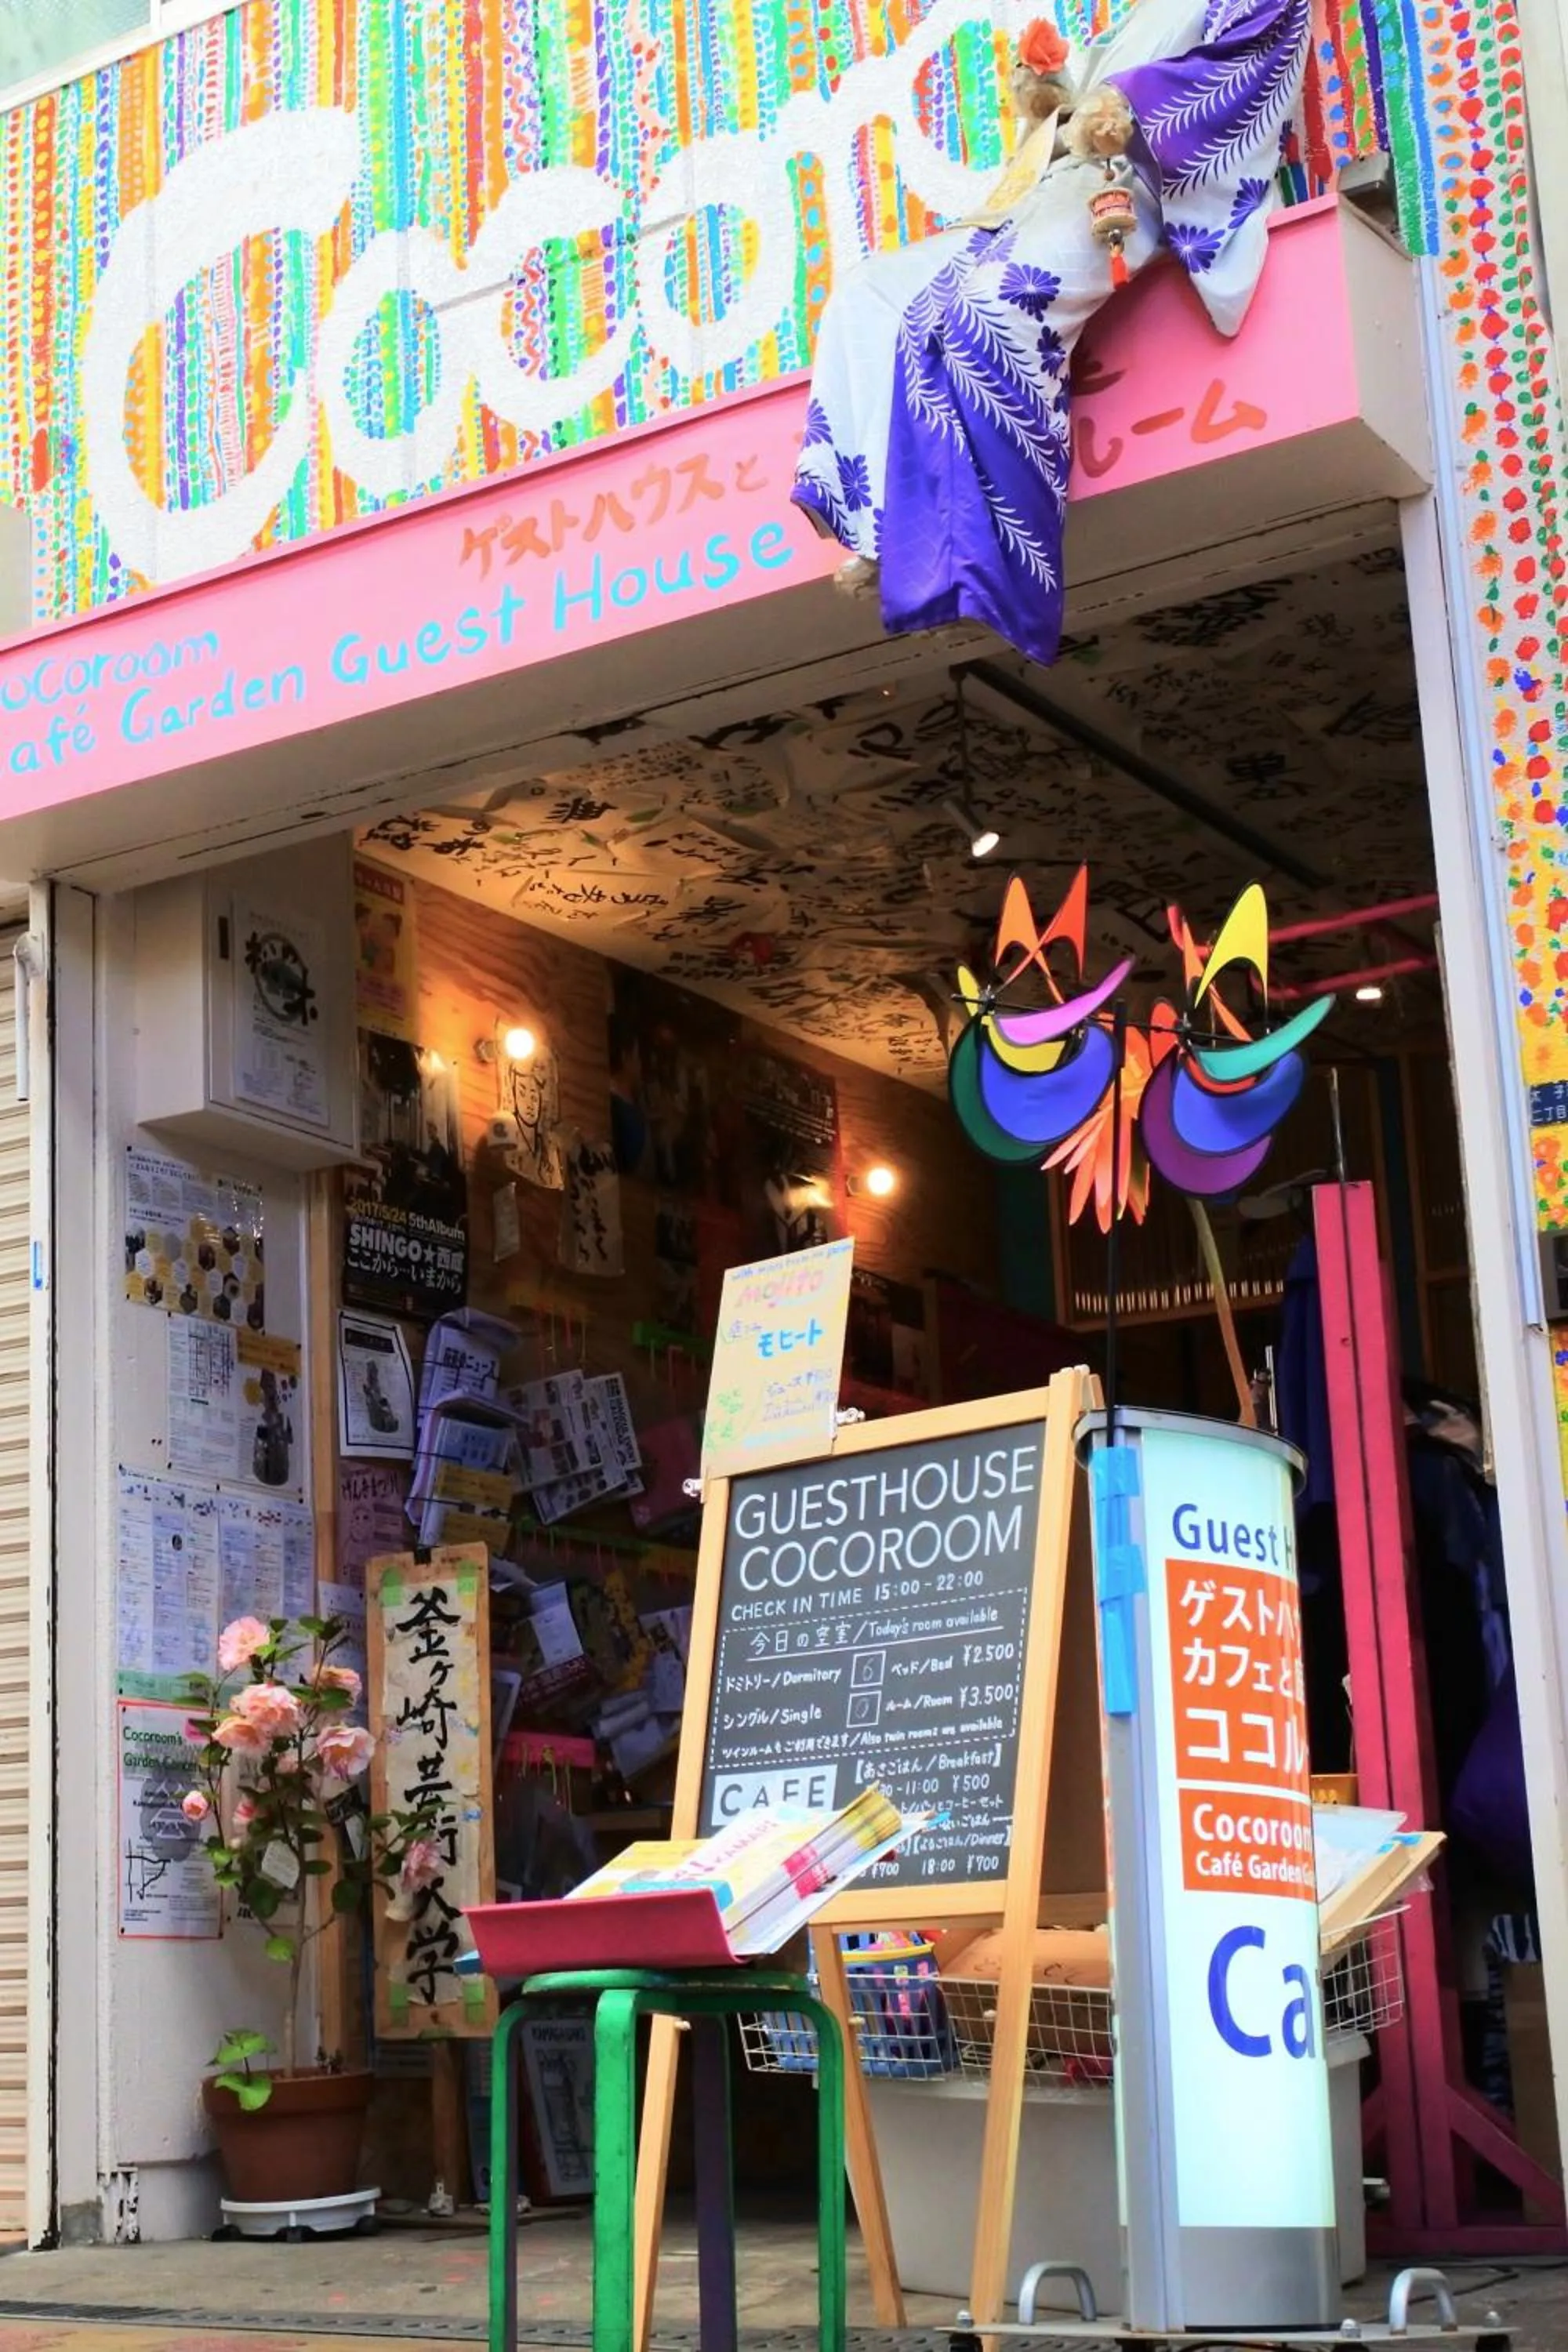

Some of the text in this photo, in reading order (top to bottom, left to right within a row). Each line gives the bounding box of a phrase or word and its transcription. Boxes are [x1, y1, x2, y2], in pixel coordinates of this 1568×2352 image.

[82, 0, 1058, 584] Cocoro
[0, 521, 794, 775] afé Garden Guest House
[756, 1317, 824, 1358] モヒート
[735, 1444, 1038, 1540] GUESTHOUSE
[739, 1504, 1023, 1592] COCOROOM
[1171, 1503, 1279, 1566] Guest
[731, 1599, 787, 1622] CHECK
[792, 1594, 813, 1613] IN
[818, 1587, 863, 1609] TIME
[1180, 1577, 1301, 1643] ゲストハ
[1185, 1707, 1308, 1775] ココル
[719, 1774, 827, 1817] CAFE
[1195, 1849, 1243, 1878] Café
[1207, 1925, 1316, 2060] Ca
